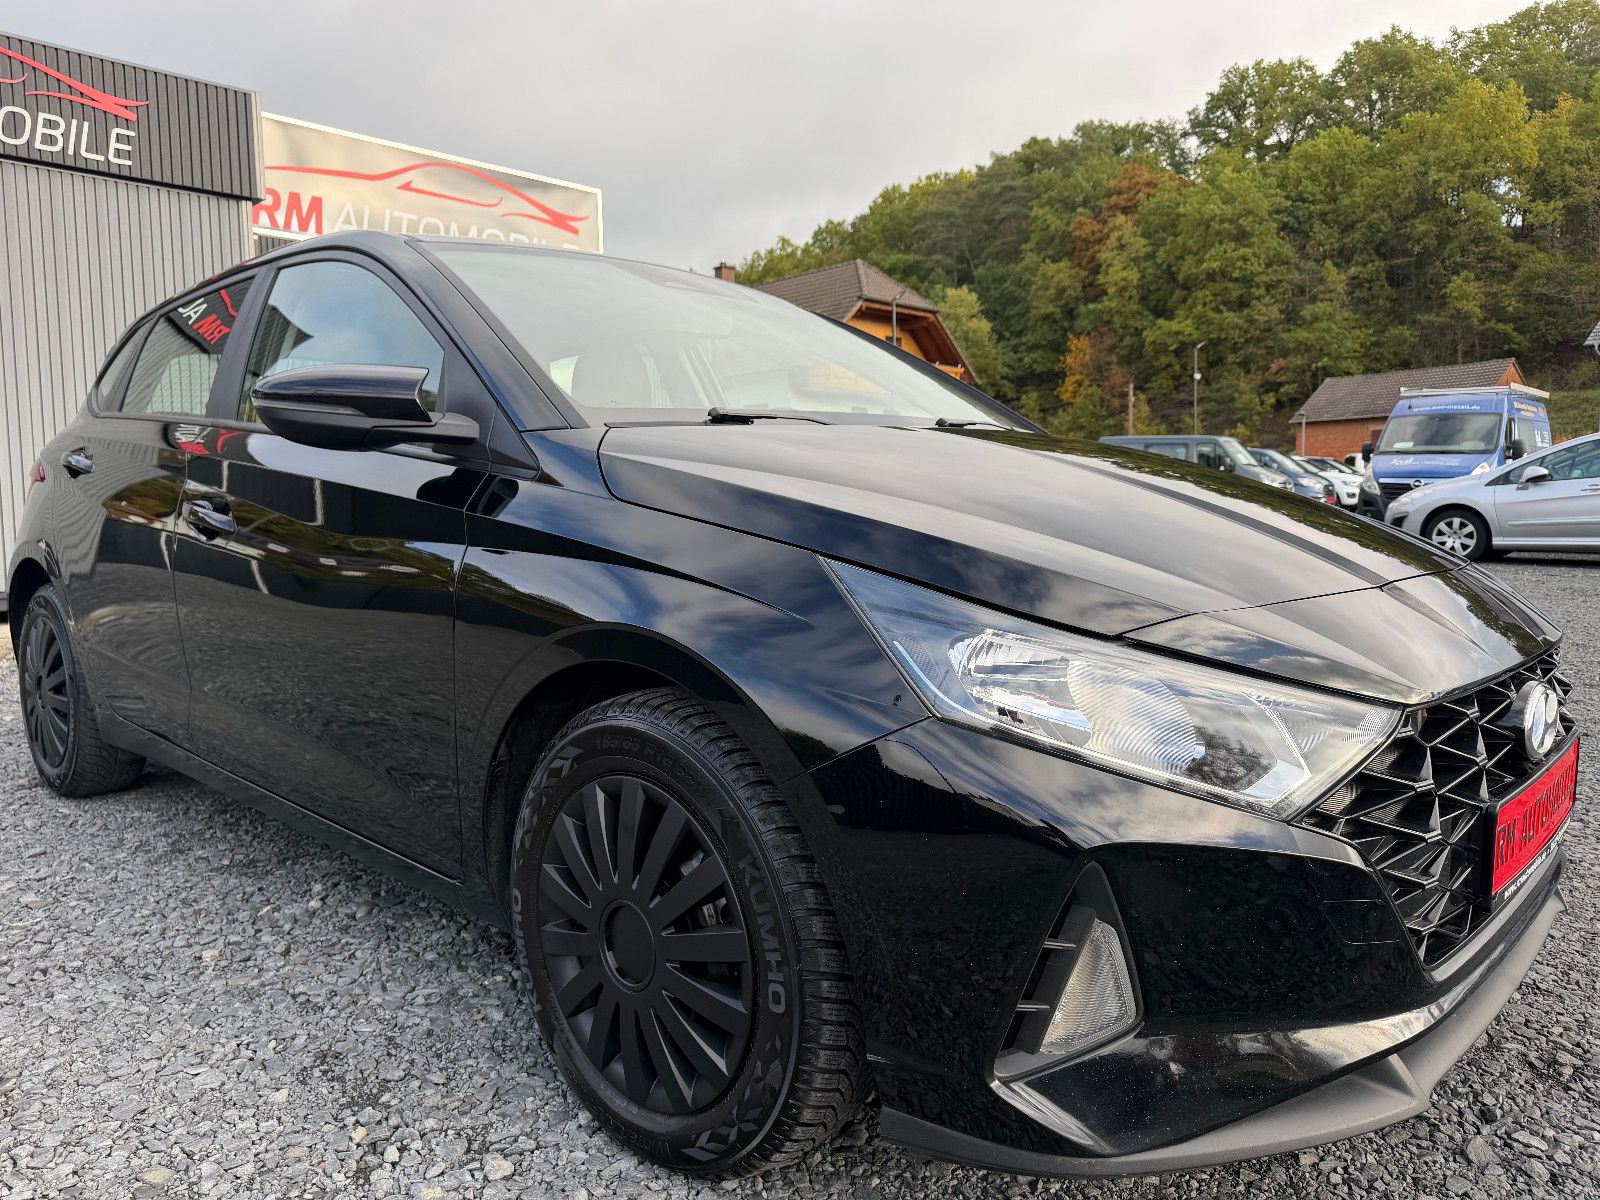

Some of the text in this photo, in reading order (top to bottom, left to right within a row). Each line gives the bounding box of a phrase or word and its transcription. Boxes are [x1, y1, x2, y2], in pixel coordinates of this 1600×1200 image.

[0, 105, 136, 166] OBILE
[252, 187, 323, 235] RM
[1495, 816, 1517, 872] RM
[738, 854, 786, 1014] KUMHO
